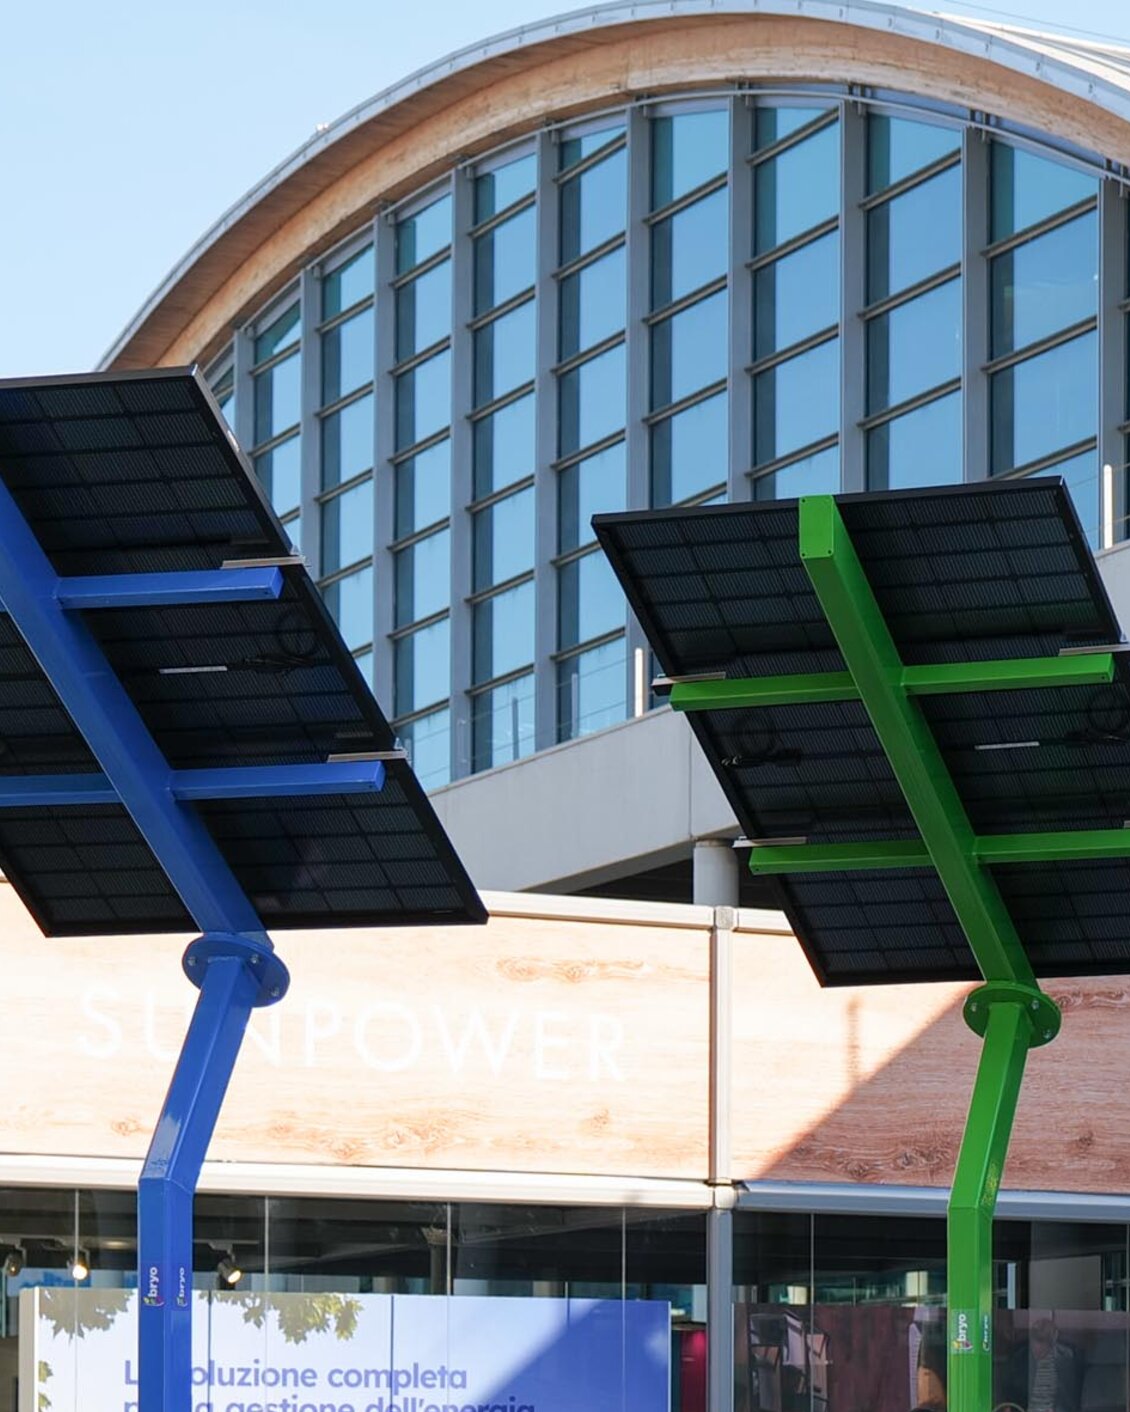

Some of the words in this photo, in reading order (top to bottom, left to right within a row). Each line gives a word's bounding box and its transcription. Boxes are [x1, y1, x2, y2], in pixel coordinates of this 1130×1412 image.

[147, 1266, 160, 1298] bryo
[956, 1313, 968, 1342] bryo
[124, 1360, 139, 1385] L
[191, 1358, 317, 1387] oluzione
[327, 1362, 467, 1396] completa
